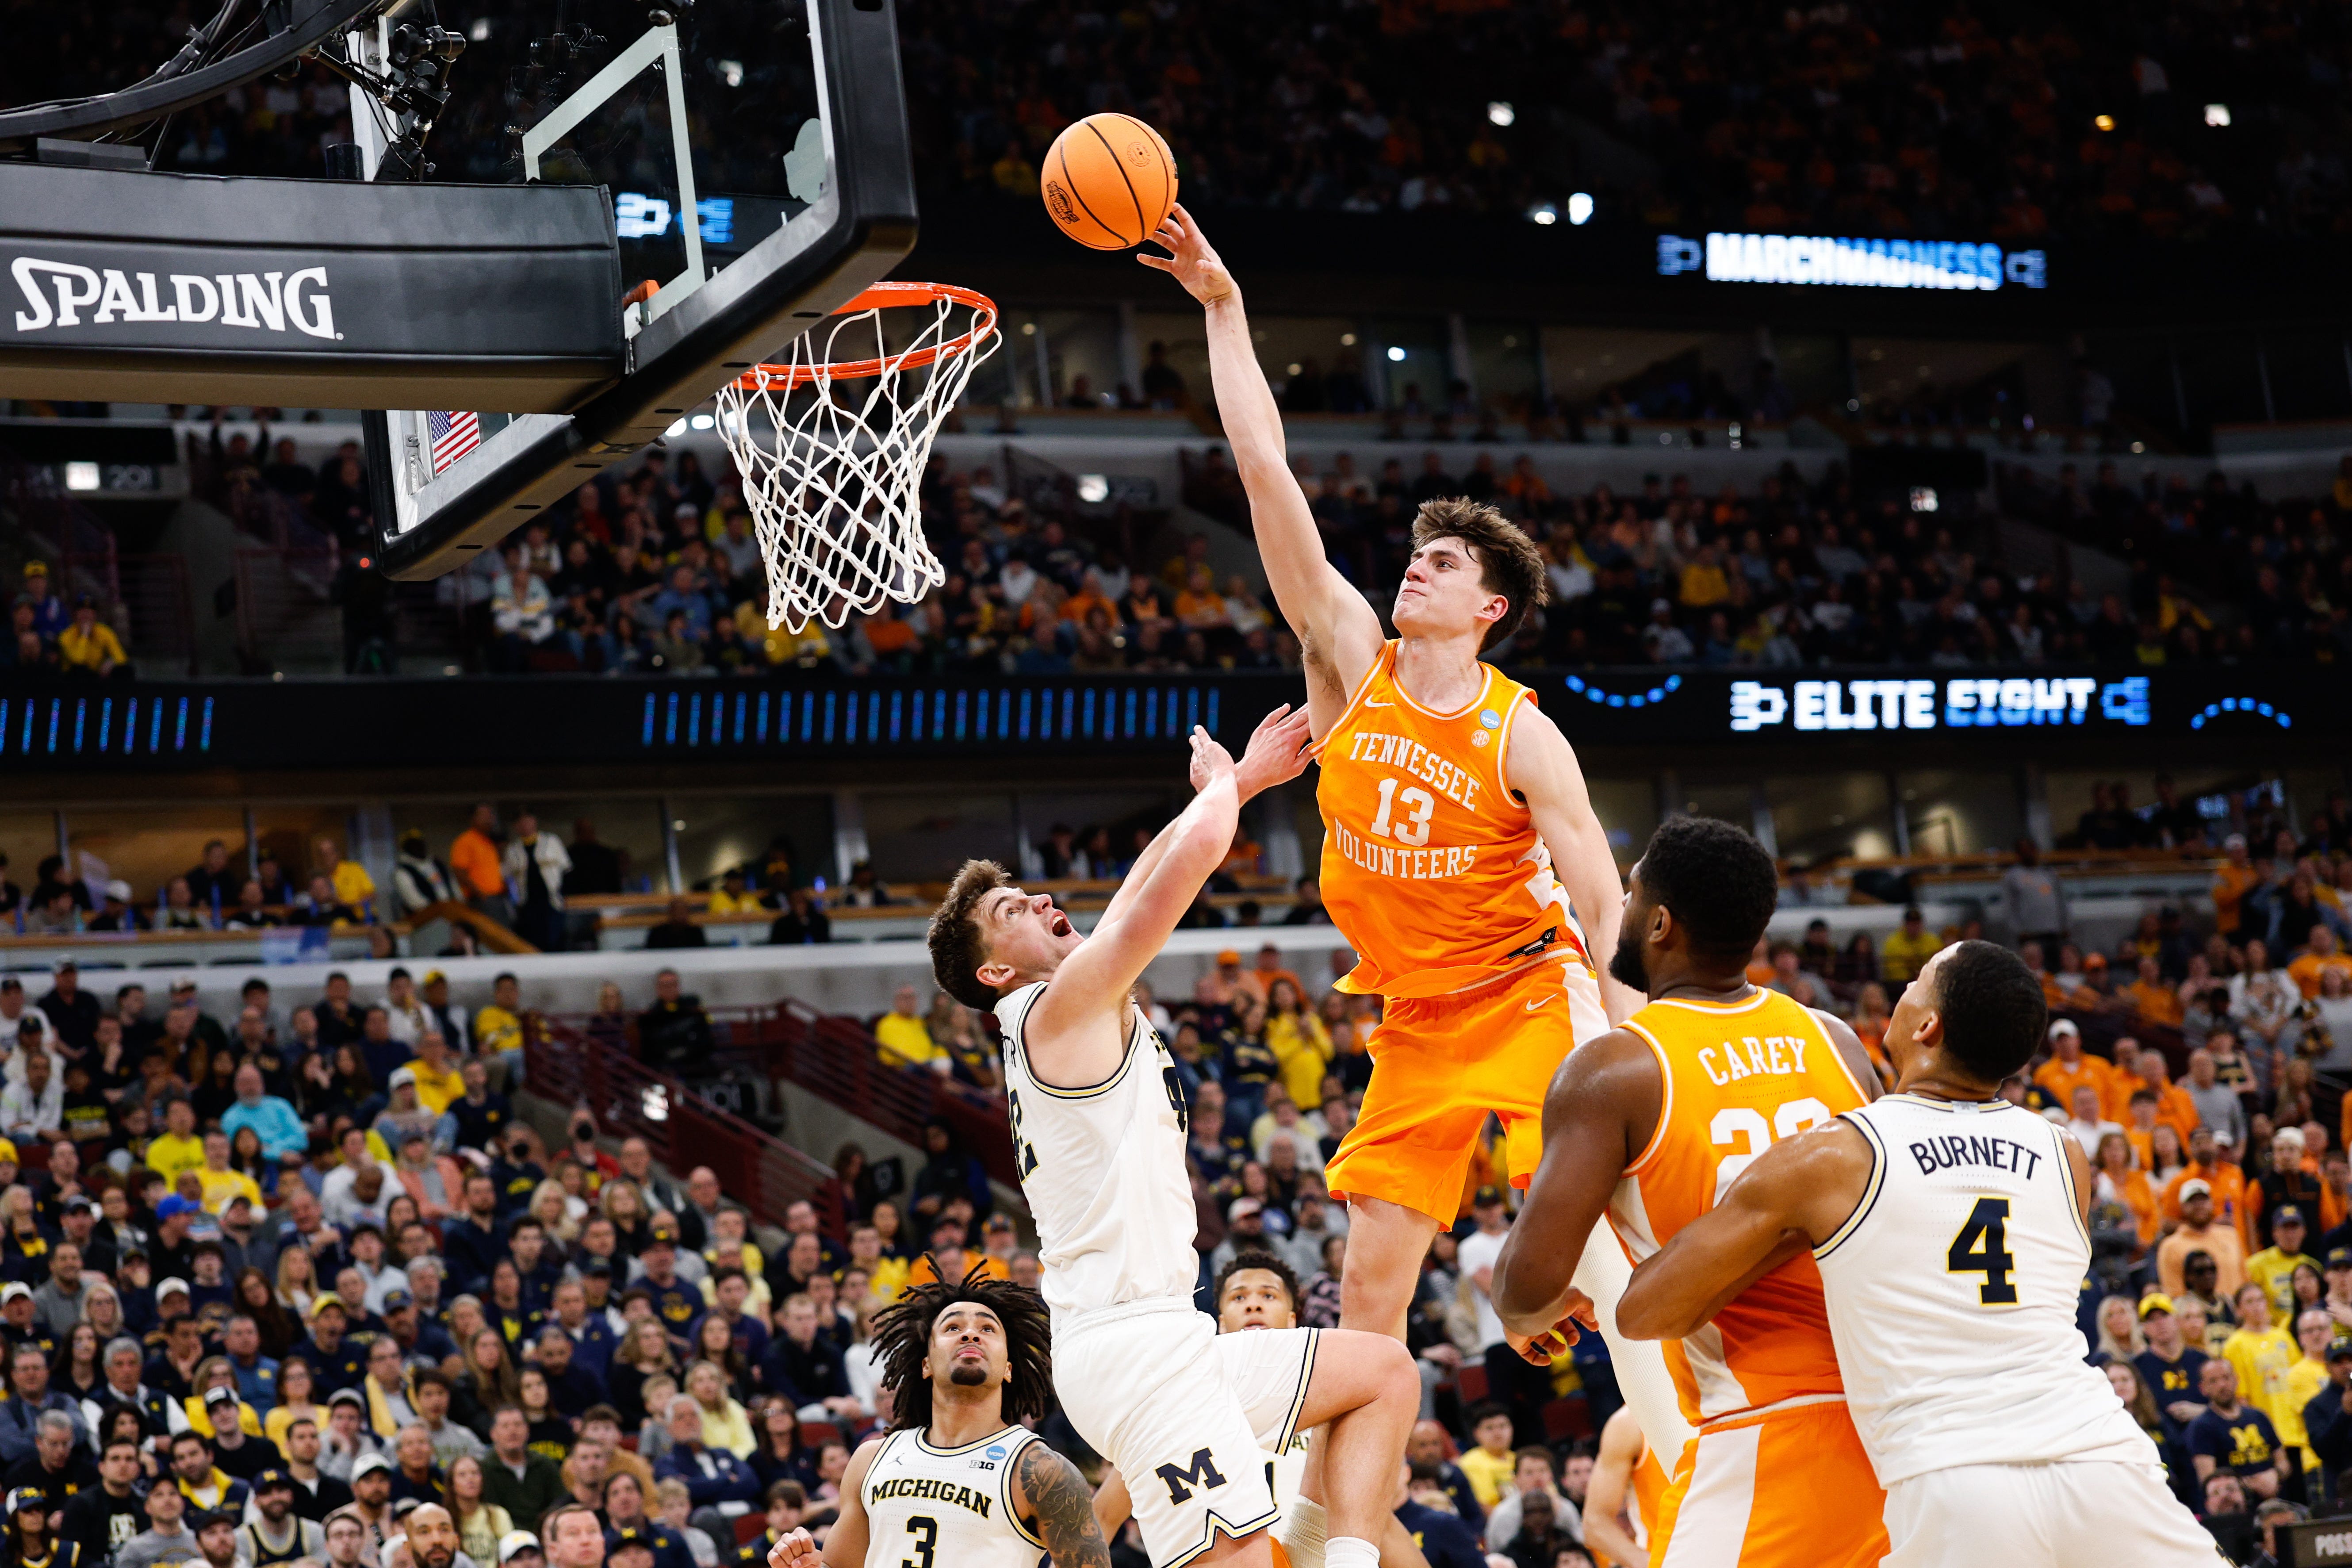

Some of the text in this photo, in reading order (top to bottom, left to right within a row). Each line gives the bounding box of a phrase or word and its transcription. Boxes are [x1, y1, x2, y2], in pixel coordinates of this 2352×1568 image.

[11, 257, 335, 340] SPALDING
[1482, 716, 1499, 726] NCAA
[1794, 678, 2096, 729] ELITE EIGHT
[1472, 731, 1487, 746] SEC
[1349, 732, 1480, 811] TENNESSEE
[1371, 778, 1434, 847] 13
[1335, 817, 1478, 879] VOLUNTEERS
[1698, 1036, 1806, 1086] CAREY
[1909, 1135, 2042, 1181] BURNETT
[1946, 1195, 2019, 1307] 4
[871, 1479, 992, 1520] MICHIGAN
[1154, 1447, 1227, 1506] M
[901, 1515, 938, 1568] 3
